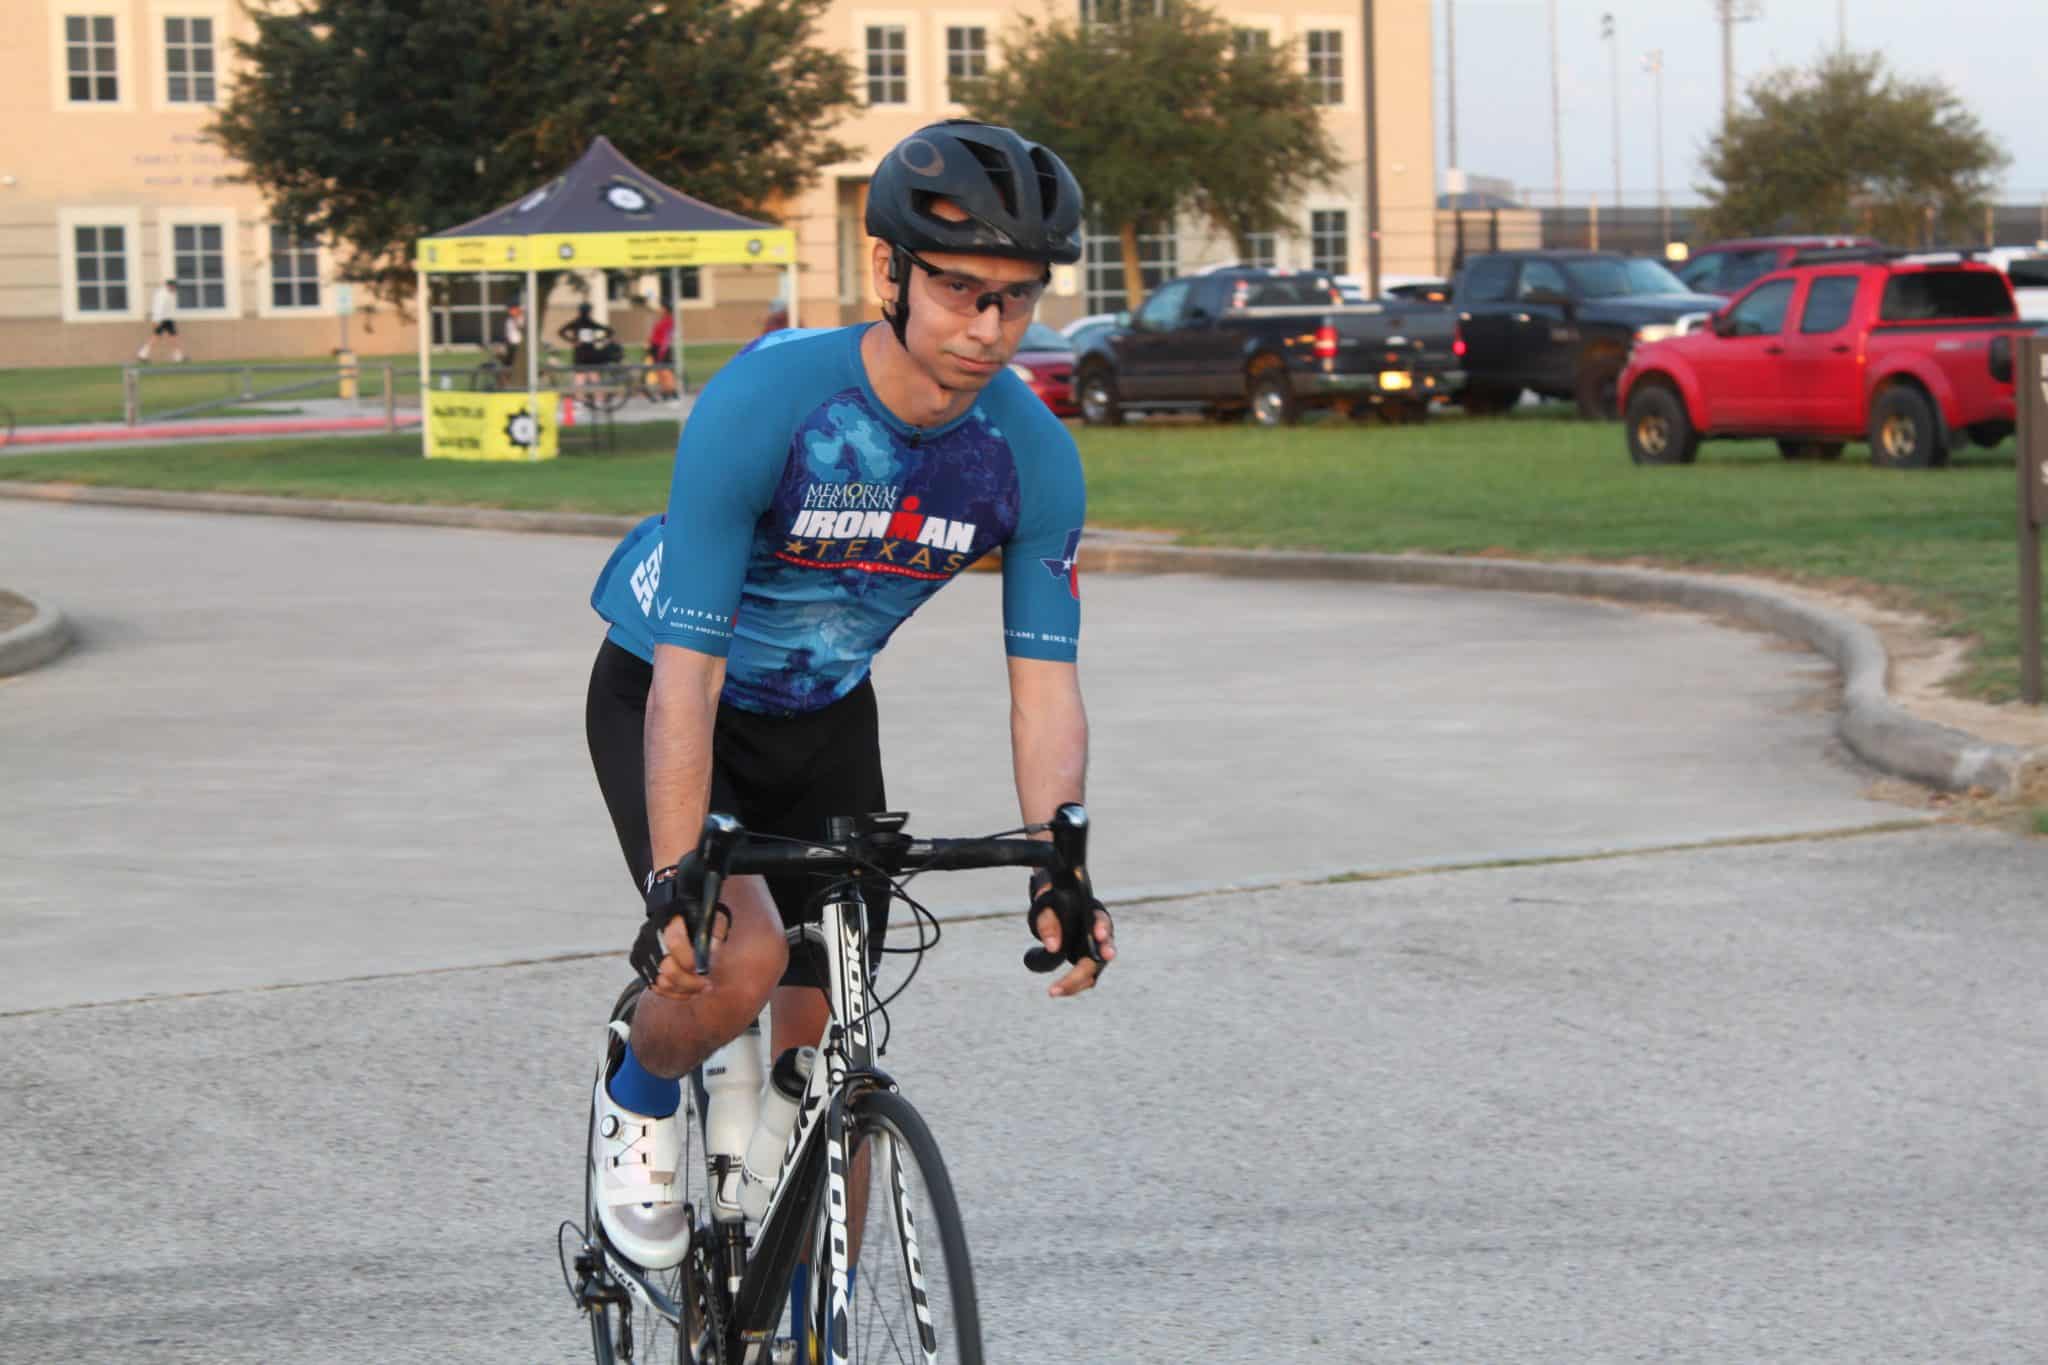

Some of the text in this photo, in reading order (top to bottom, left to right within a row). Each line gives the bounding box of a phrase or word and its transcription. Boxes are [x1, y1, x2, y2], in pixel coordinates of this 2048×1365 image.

[803, 494, 896, 510] HERMANN
[808, 482, 898, 499] MEMORIAL
[790, 497, 976, 553] IRONMAN
[815, 539, 965, 572] TEXAS
[672, 607, 729, 622] VINFAST
[846, 924, 867, 1048] LOOK
[827, 1139, 848, 1320] LOOK
